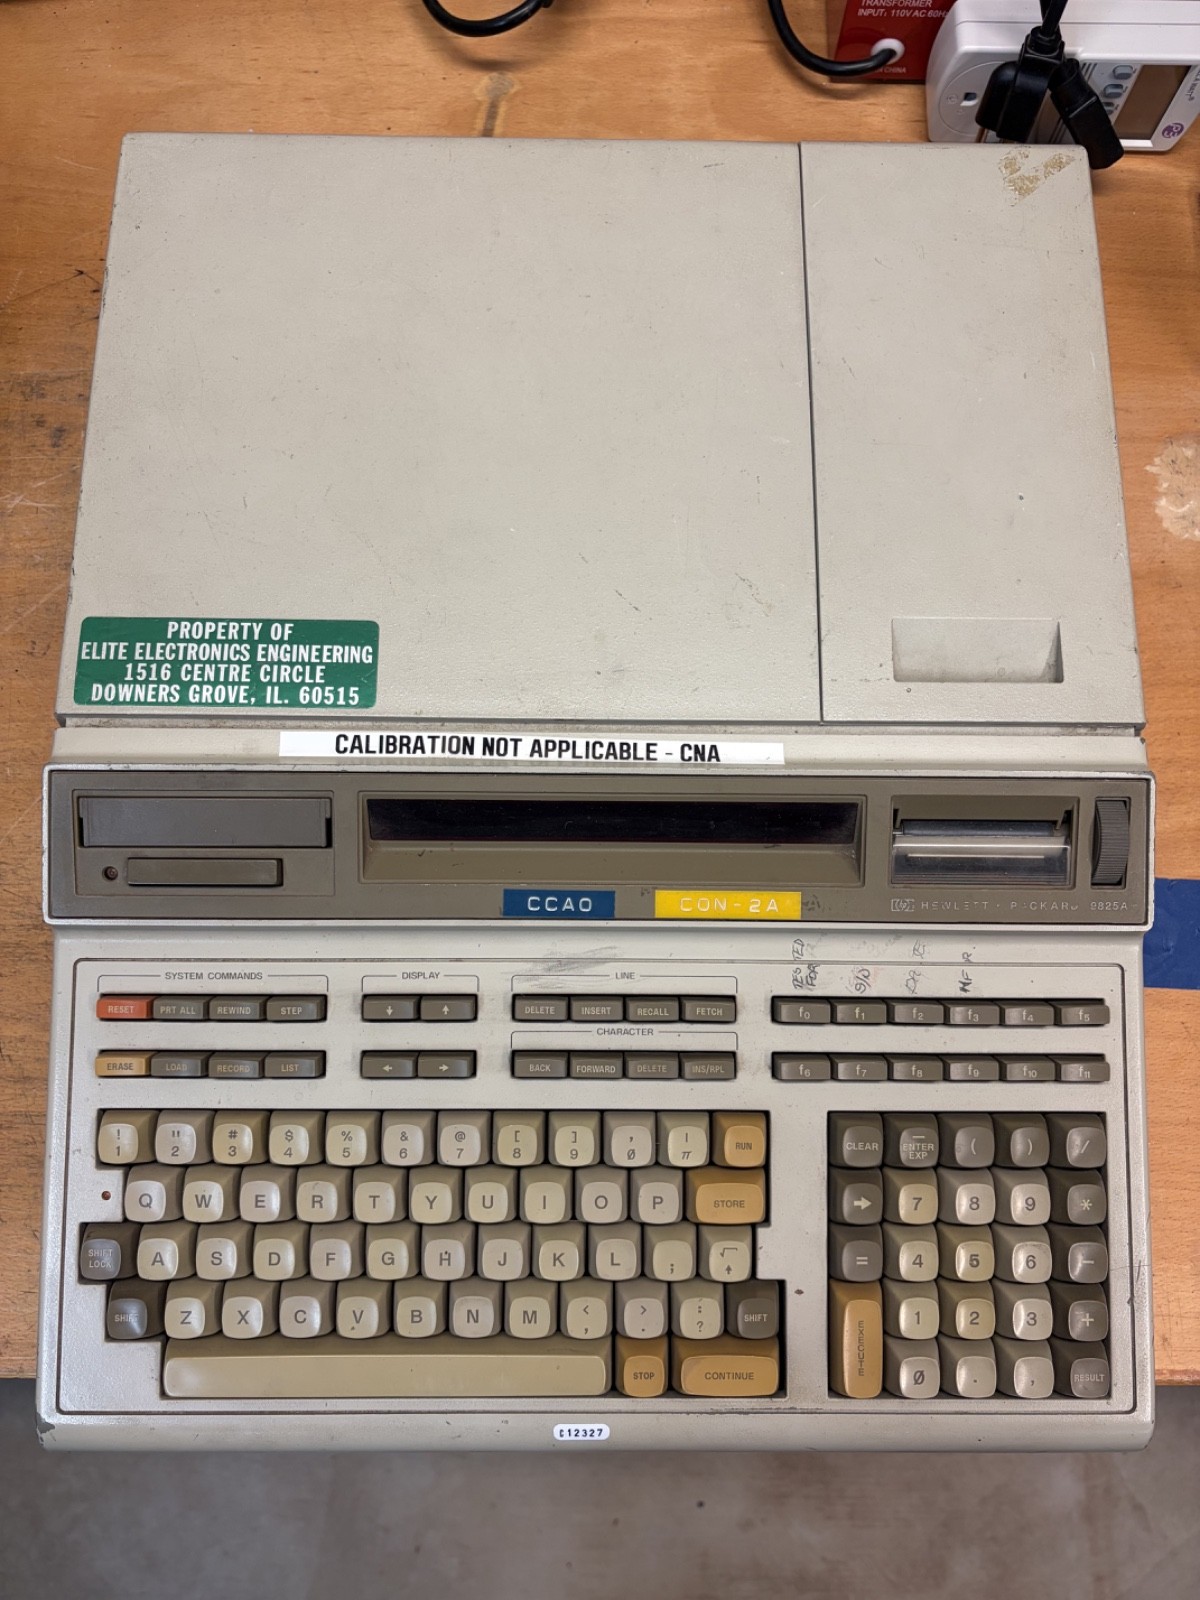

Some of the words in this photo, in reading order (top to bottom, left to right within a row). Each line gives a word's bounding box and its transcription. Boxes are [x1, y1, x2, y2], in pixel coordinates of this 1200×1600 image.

[167, 621, 263, 641] PROPERTY
[270, 623, 294, 641] OF
[81, 641, 127, 659] ELITE
[134, 642, 250, 661] ELECTRONICS
[257, 644, 373, 663] ENGINEERING
[124, 663, 171, 681] 1516
[181, 664, 251, 681] CENTRE
[259, 665, 326, 683] CIRCLE
[91, 683, 180, 702] DOWNERS
[189, 684, 256, 705] GROVE,
[266, 686, 289, 704] IL.
[299, 686, 359, 705] 60515
[335, 734, 475, 756] CALIBRATION
[481, 738, 522, 757] NOT
[530, 739, 658, 761] APPLICABLE
[680, 743, 721, 763] CNA
[1090, 901, 1128, 911] 9825A
[165, 972, 204, 980] SYSTEM
[208, 972, 263, 980] COMMANDS
[615, 972, 635, 980] LINE
[108, 1006, 134, 1014] RESET
[160, 1006, 177, 1014] PRT
[280, 1007, 302, 1015] STEP
[525, 1006, 555, 1014] DELETE
[581, 1007, 611, 1015] INSERT
[637, 1008, 669, 1016] RECALL
[696, 1008, 723, 1016] FETCH
[597, 1028, 654, 1036] CHARACTER
[107, 1063, 133, 1071] ERASE
[166, 1063, 187, 1071] LOAD
[217, 1064, 250, 1073] RECORD
[281, 1064, 299, 1072] LIST
[529, 1064, 551, 1072] BACK
[576, 1065, 616, 1073] FORWARD
[637, 1064, 667, 1072] DELETE
[692, 1065, 724, 1073] INS/RPL
[228, 1130, 238, 1139] #
[285, 1130, 293, 1142] $
[342, 1131, 353, 1141] %
[400, 1131, 408, 1141] &
[455, 1131, 466, 1142] @
[515, 1130, 520, 1142] [
[572, 1131, 577, 1143] ]
[116, 1146, 121, 1156] 1
[172, 1146, 179, 1156] 2
[228, 1146, 236, 1156] 3
[736, 1142, 752, 1150] RUN
[846, 1142, 879, 1151] CLEAR
[970, 1138, 976, 1155] (
[1028, 1139, 1033, 1155] )
[1081, 1140, 1090, 1153] /
[284, 1148, 293, 1157] 4
[342, 1148, 350, 1158] 5
[400, 1148, 407, 1159] 6
[457, 1149, 464, 1159] 7
[513, 1149, 521, 1159] 8
[570, 1150, 578, 1159] 9
[139, 1193, 152, 1208] Q
[195, 1195, 212, 1208] W
[255, 1195, 266, 1208] E
[312, 1195, 323, 1208] R
[369, 1195, 380, 1208] T
[426, 1196, 437, 1209] Y
[483, 1195, 493, 1209] U
[595, 1195, 608, 1209] O
[653, 1196, 664, 1209] P
[714, 1200, 745, 1208] STORE
[912, 1197, 922, 1210] 7
[969, 1197, 979, 1210] 8
[1025, 1197, 1035, 1211] 9
[151, 1252, 165, 1266] A
[211, 1252, 222, 1266] S
[268, 1252, 280, 1266] D
[325, 1253, 336, 1266] F
[381, 1252, 395, 1266] G
[439, 1252, 450, 1266] H
[498, 1253, 506, 1267] J
[553, 1253, 565, 1267] K
[610, 1253, 620, 1266] L
[912, 1254, 923, 1268] 4
[969, 1254, 979, 1268] 5
[1026, 1255, 1036, 1269] 6
[670, 1263, 674, 1274] ;
[583, 1305, 589, 1315] <
[641, 1305, 646, 1315] >
[114, 1314, 139, 1322] SHIFT
[181, 1311, 192, 1324] Z
[237, 1311, 249, 1324] X
[294, 1310, 307, 1324] C
[353, 1310, 364, 1324] V
[411, 1310, 422, 1323] B
[467, 1310, 478, 1323] N
[523, 1311, 537, 1324] M
[744, 1314, 767, 1322] SHIFT
[915, 1311, 920, 1324] 1
[970, 1311, 979, 1325] 2
[1026, 1312, 1037, 1326] 3
[1081, 1313, 1094, 1327] +
[697, 1321, 703, 1332] ?
[633, 1372, 655, 1380] STOP
[705, 1372, 754, 1380] CONTINUE
[1074, 1374, 1105, 1382] RESULT
